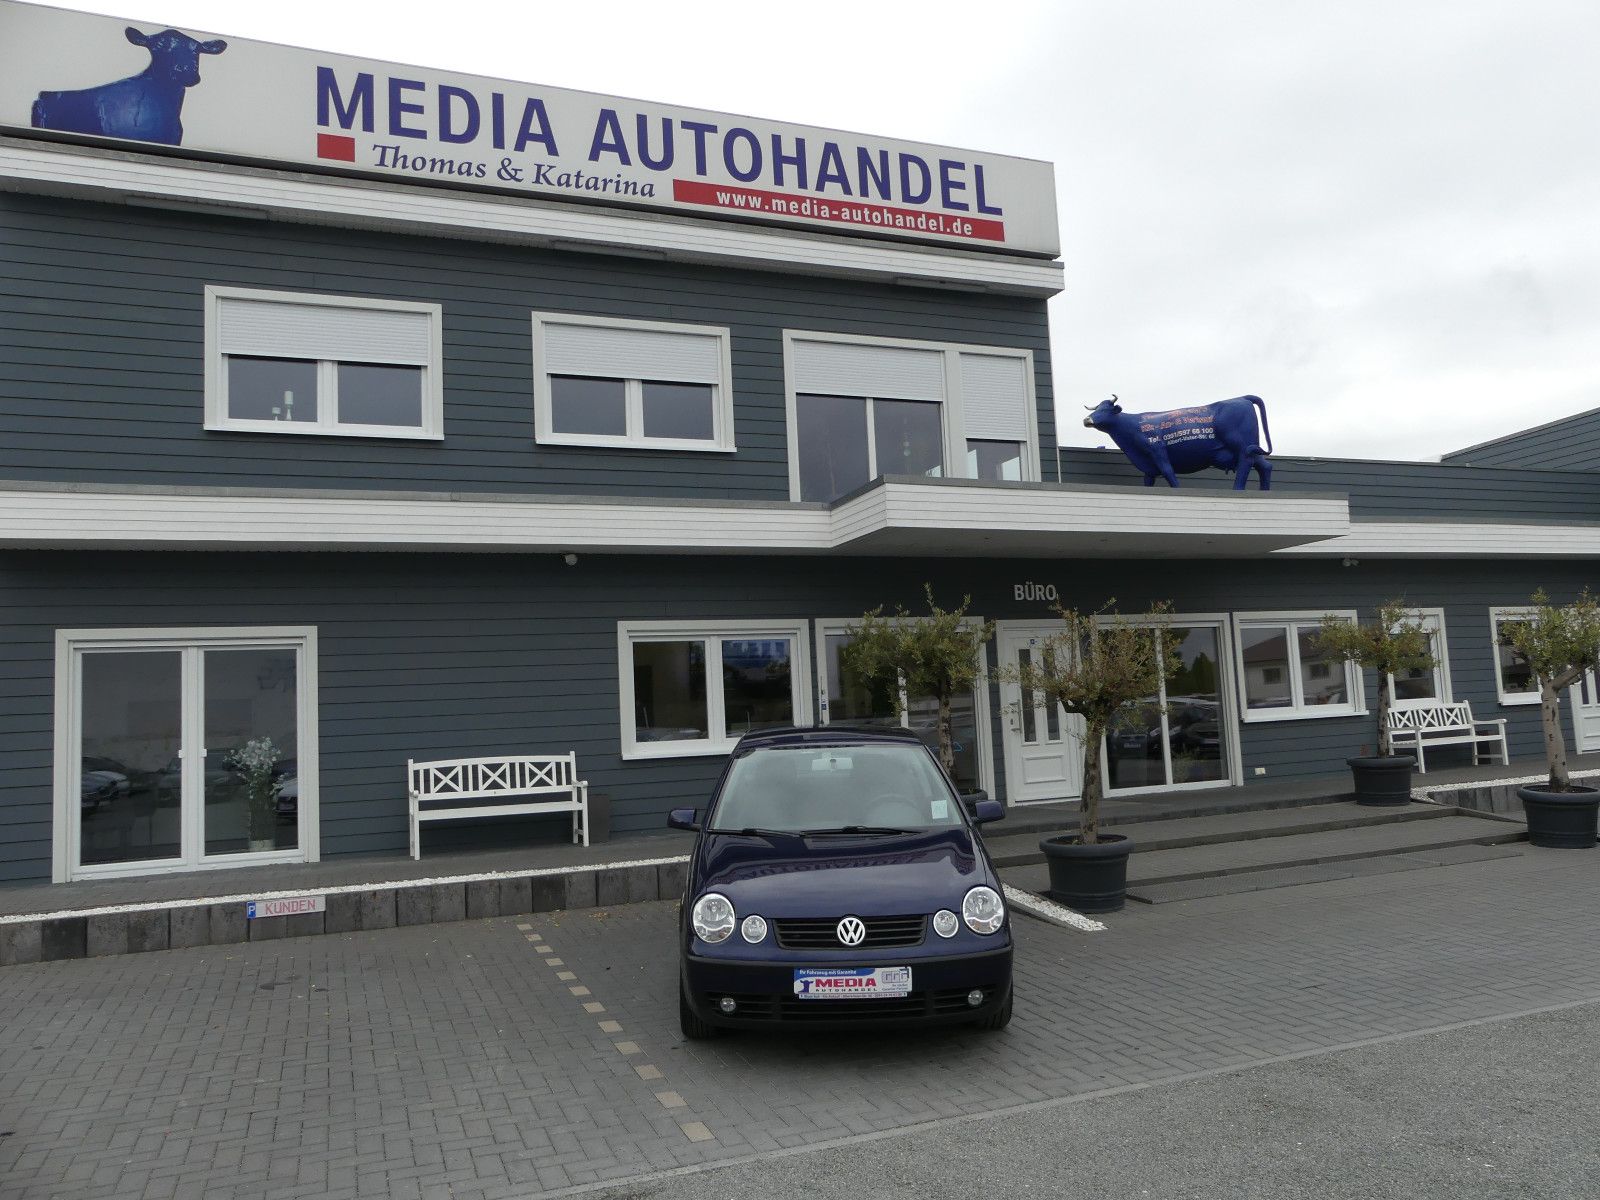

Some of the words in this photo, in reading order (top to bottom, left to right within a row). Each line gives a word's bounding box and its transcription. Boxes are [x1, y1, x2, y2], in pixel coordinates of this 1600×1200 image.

[317, 66, 559, 157] MEDIA
[588, 108, 1003, 216] AUTOHANDEL
[372, 144, 487, 178] Thomas
[497, 157, 524, 183] &
[532, 163, 655, 198] Katarina
[716, 189, 973, 236] www.media-autohandel.de
[1014, 581, 1057, 601] BÜRO
[248, 905, 256, 915] P
[265, 899, 316, 915] KUNDEN
[815, 978, 877, 988] MEDIA
